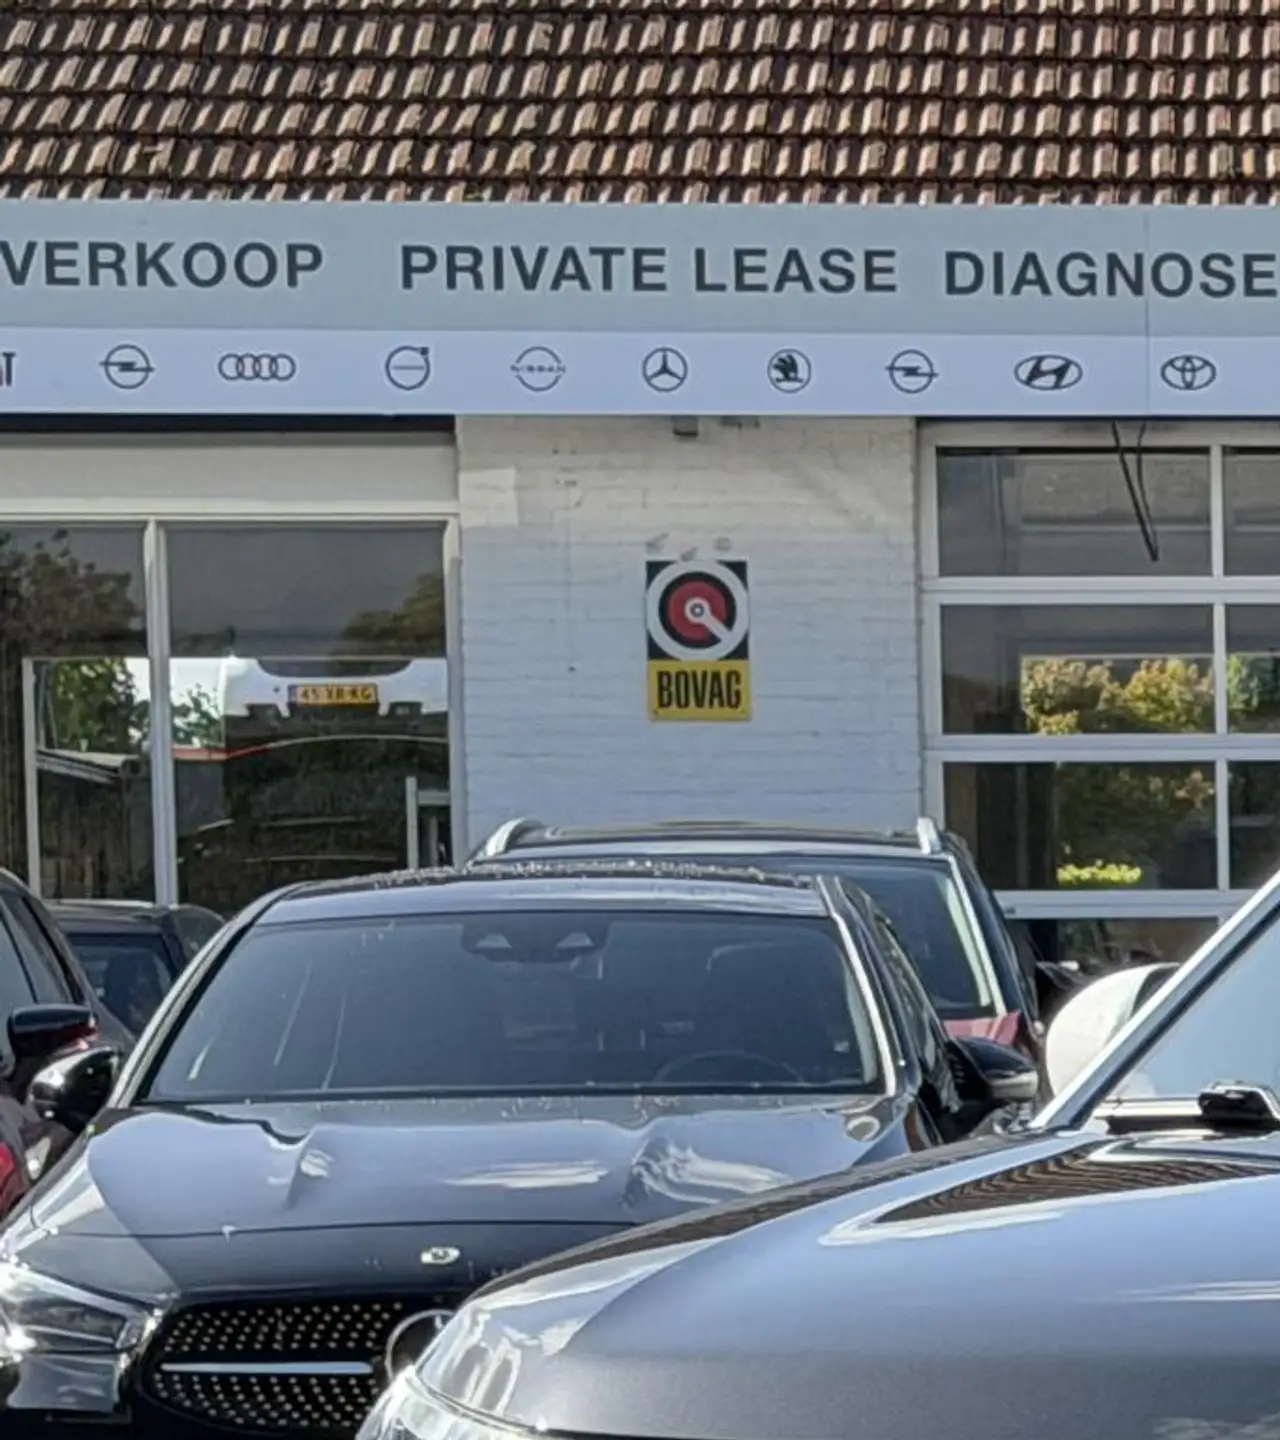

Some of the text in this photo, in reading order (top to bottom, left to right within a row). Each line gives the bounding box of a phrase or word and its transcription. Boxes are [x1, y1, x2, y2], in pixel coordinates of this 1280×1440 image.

[0, 240, 323, 287] VERKOOP
[401, 245, 897, 294] PRIVATE LEASE
[945, 250, 1278, 299] DIAGNOSE
